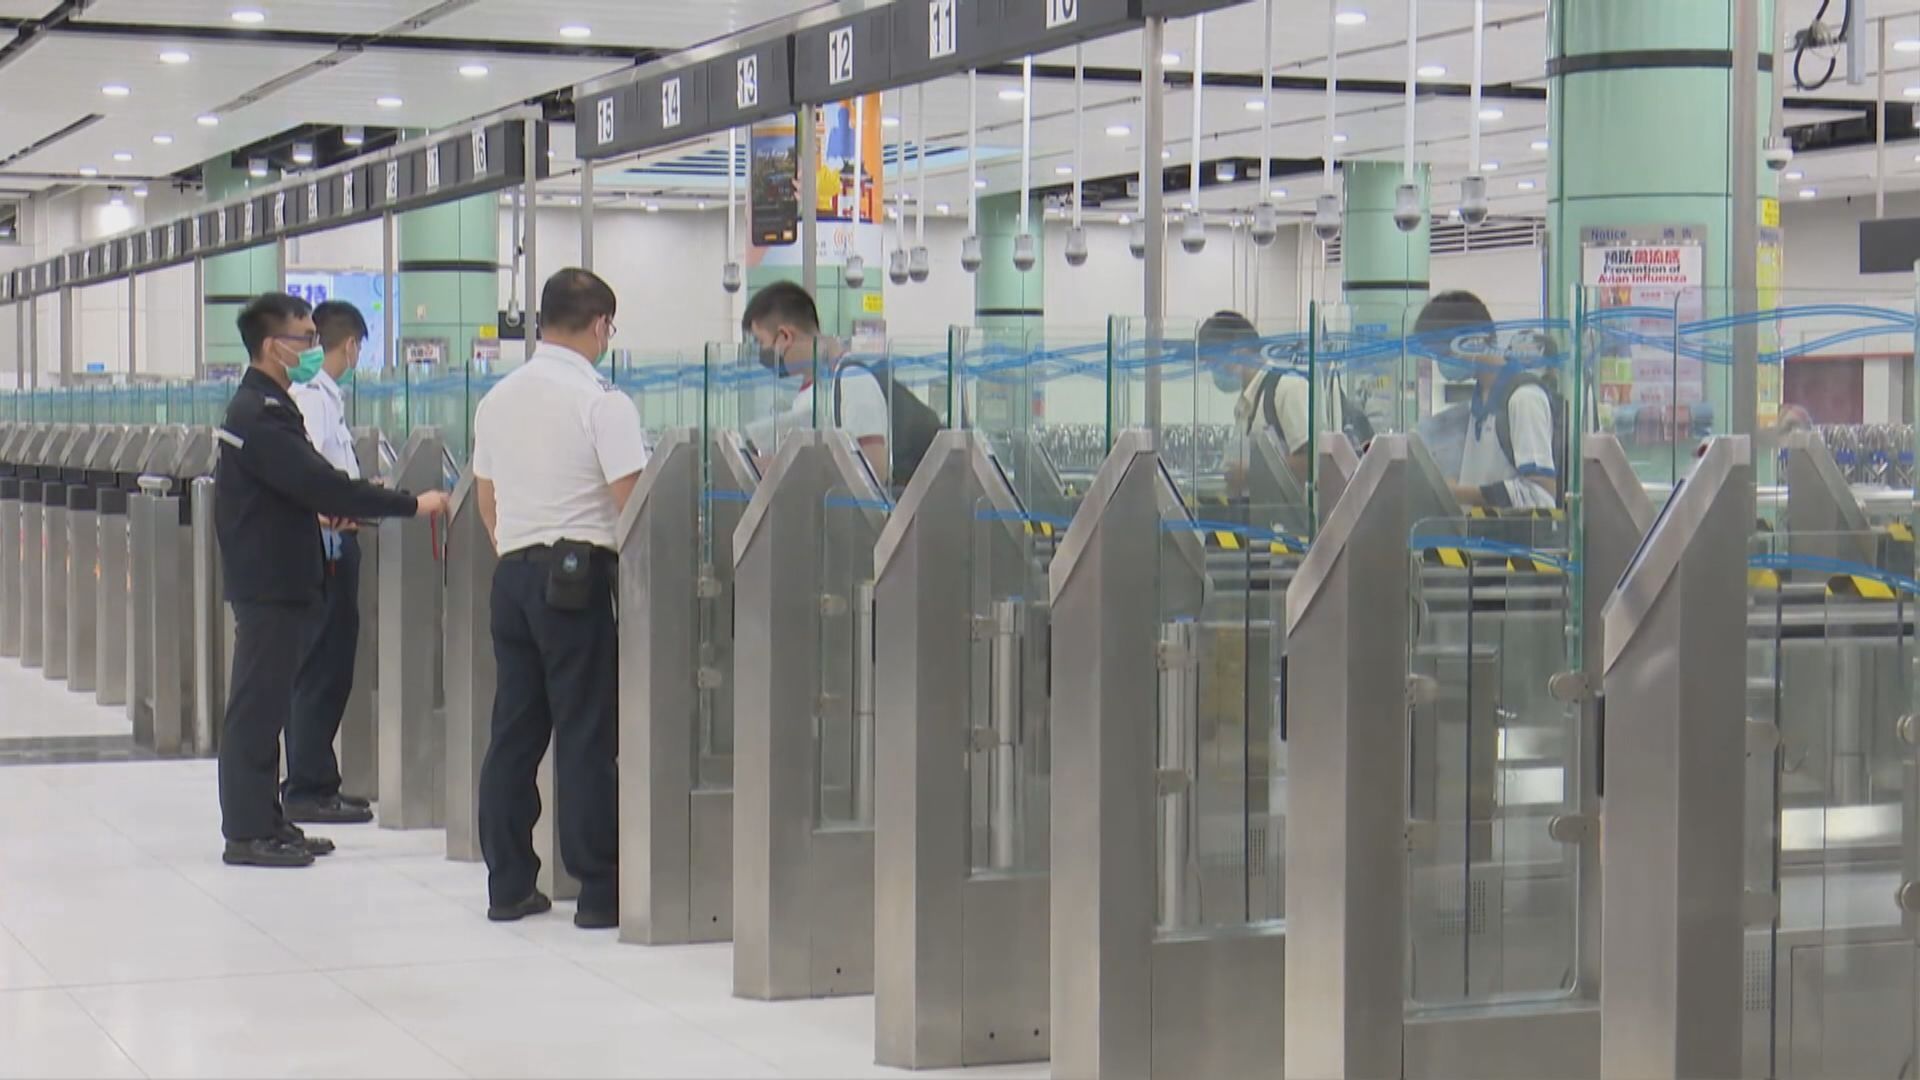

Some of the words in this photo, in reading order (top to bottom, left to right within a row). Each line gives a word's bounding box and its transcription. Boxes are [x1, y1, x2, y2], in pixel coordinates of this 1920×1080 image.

[934, 2, 952, 51] 11
[831, 32, 851, 80] 12
[740, 59, 755, 103] 13
[599, 102, 612, 140] 15
[664, 83, 679, 125] 14
[474, 133, 485, 171] 16
[1591, 228, 1627, 240] Notice
[1598, 274, 1629, 284] Avian
[1632, 274, 1687, 284] Influenza
[1603, 264, 1666, 274] Prevention
[1669, 264, 1681, 274] of
